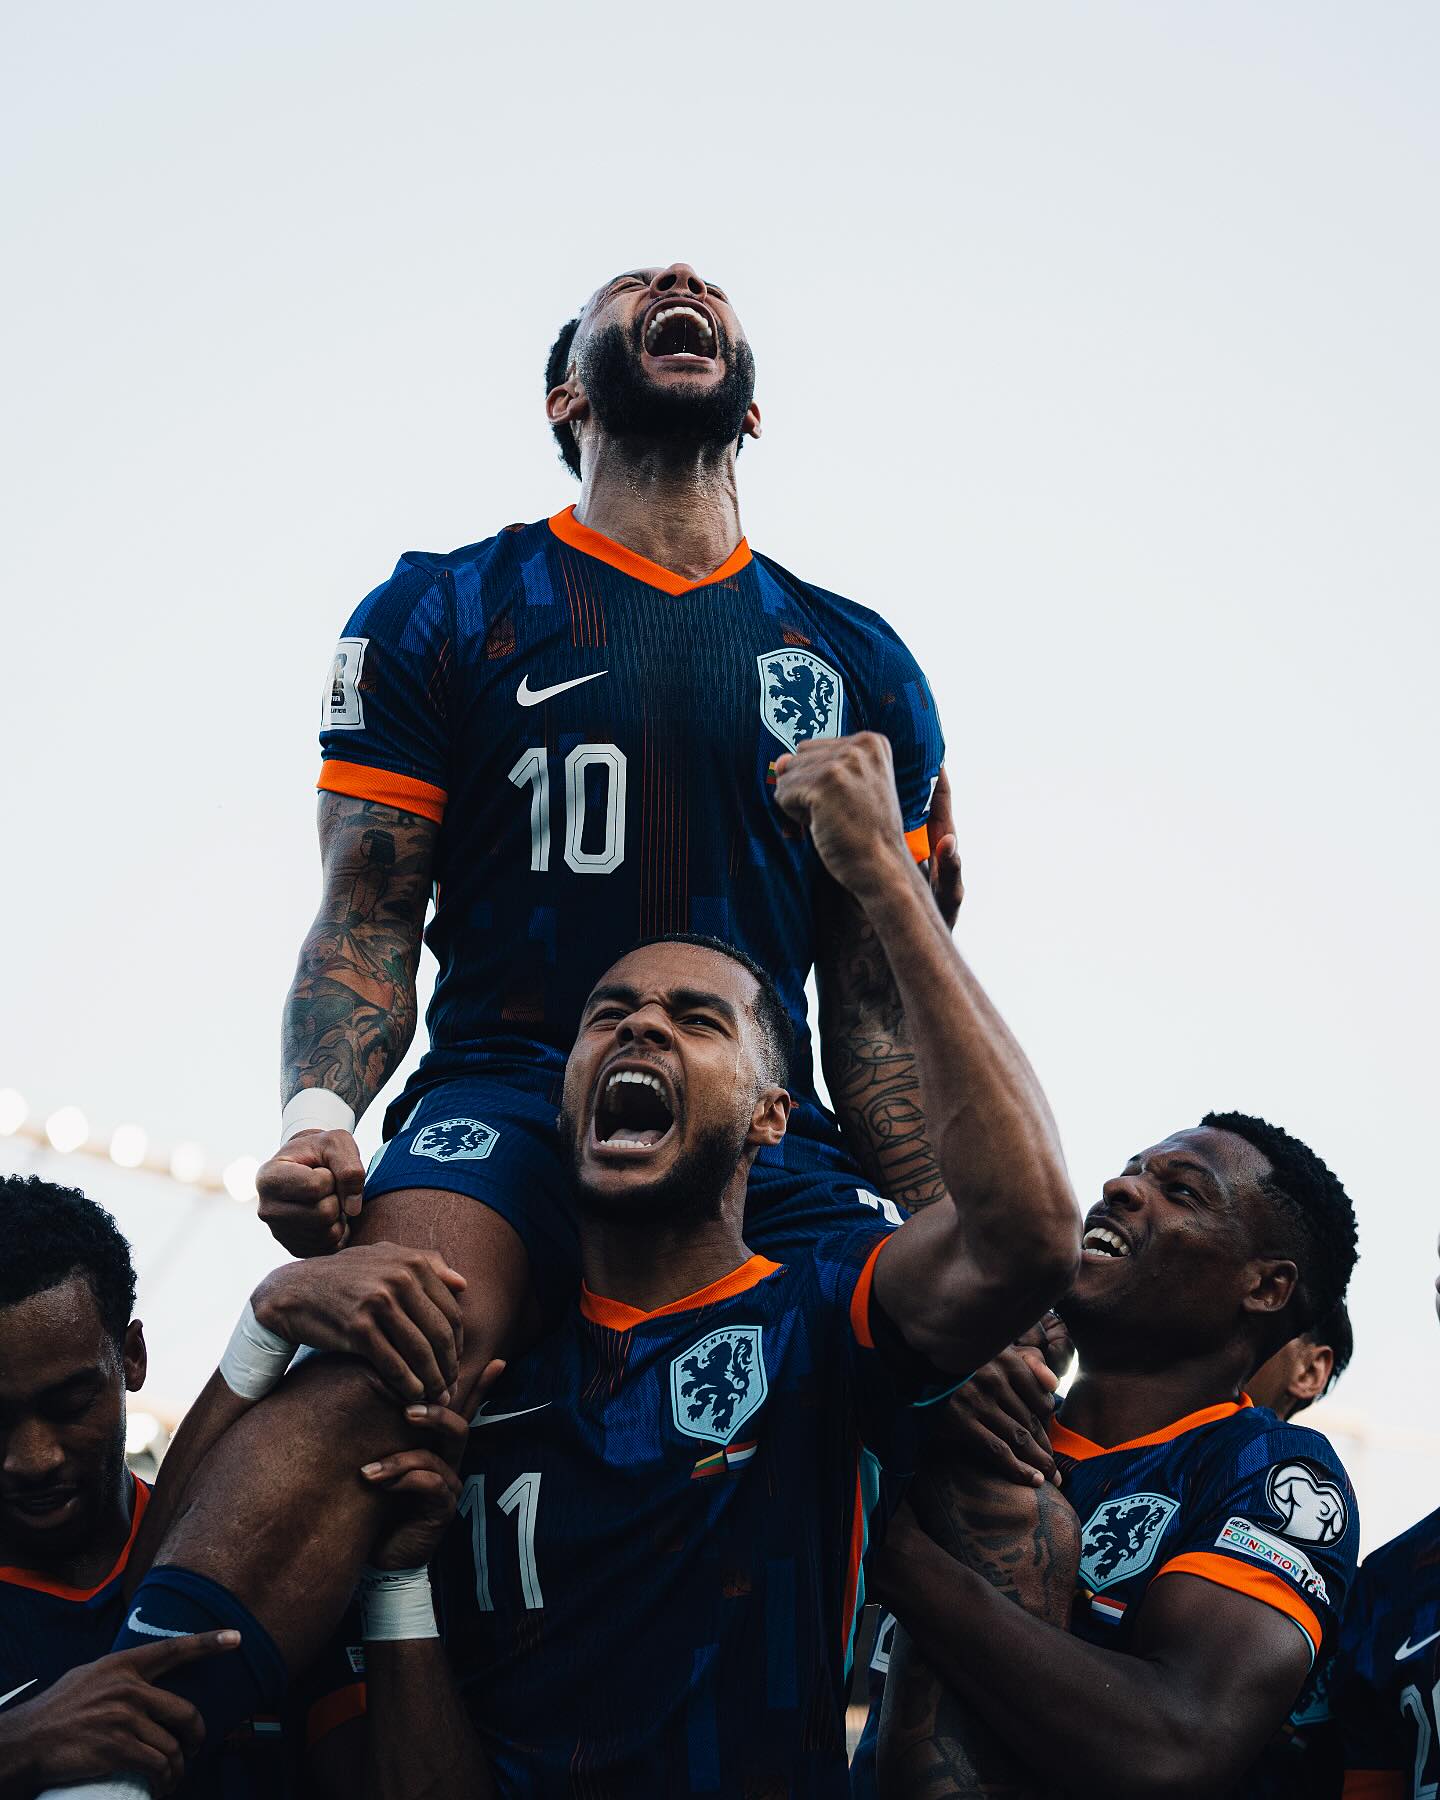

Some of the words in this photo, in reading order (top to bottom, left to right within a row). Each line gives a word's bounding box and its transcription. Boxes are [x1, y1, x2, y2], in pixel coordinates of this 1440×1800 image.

[507, 743, 628, 874] 10
[456, 1472, 544, 1611] 11
[1222, 1528, 1300, 1577] FOUNDATION
[1230, 1518, 1252, 1532] UEFA
[1400, 1679, 1440, 1800] 2
